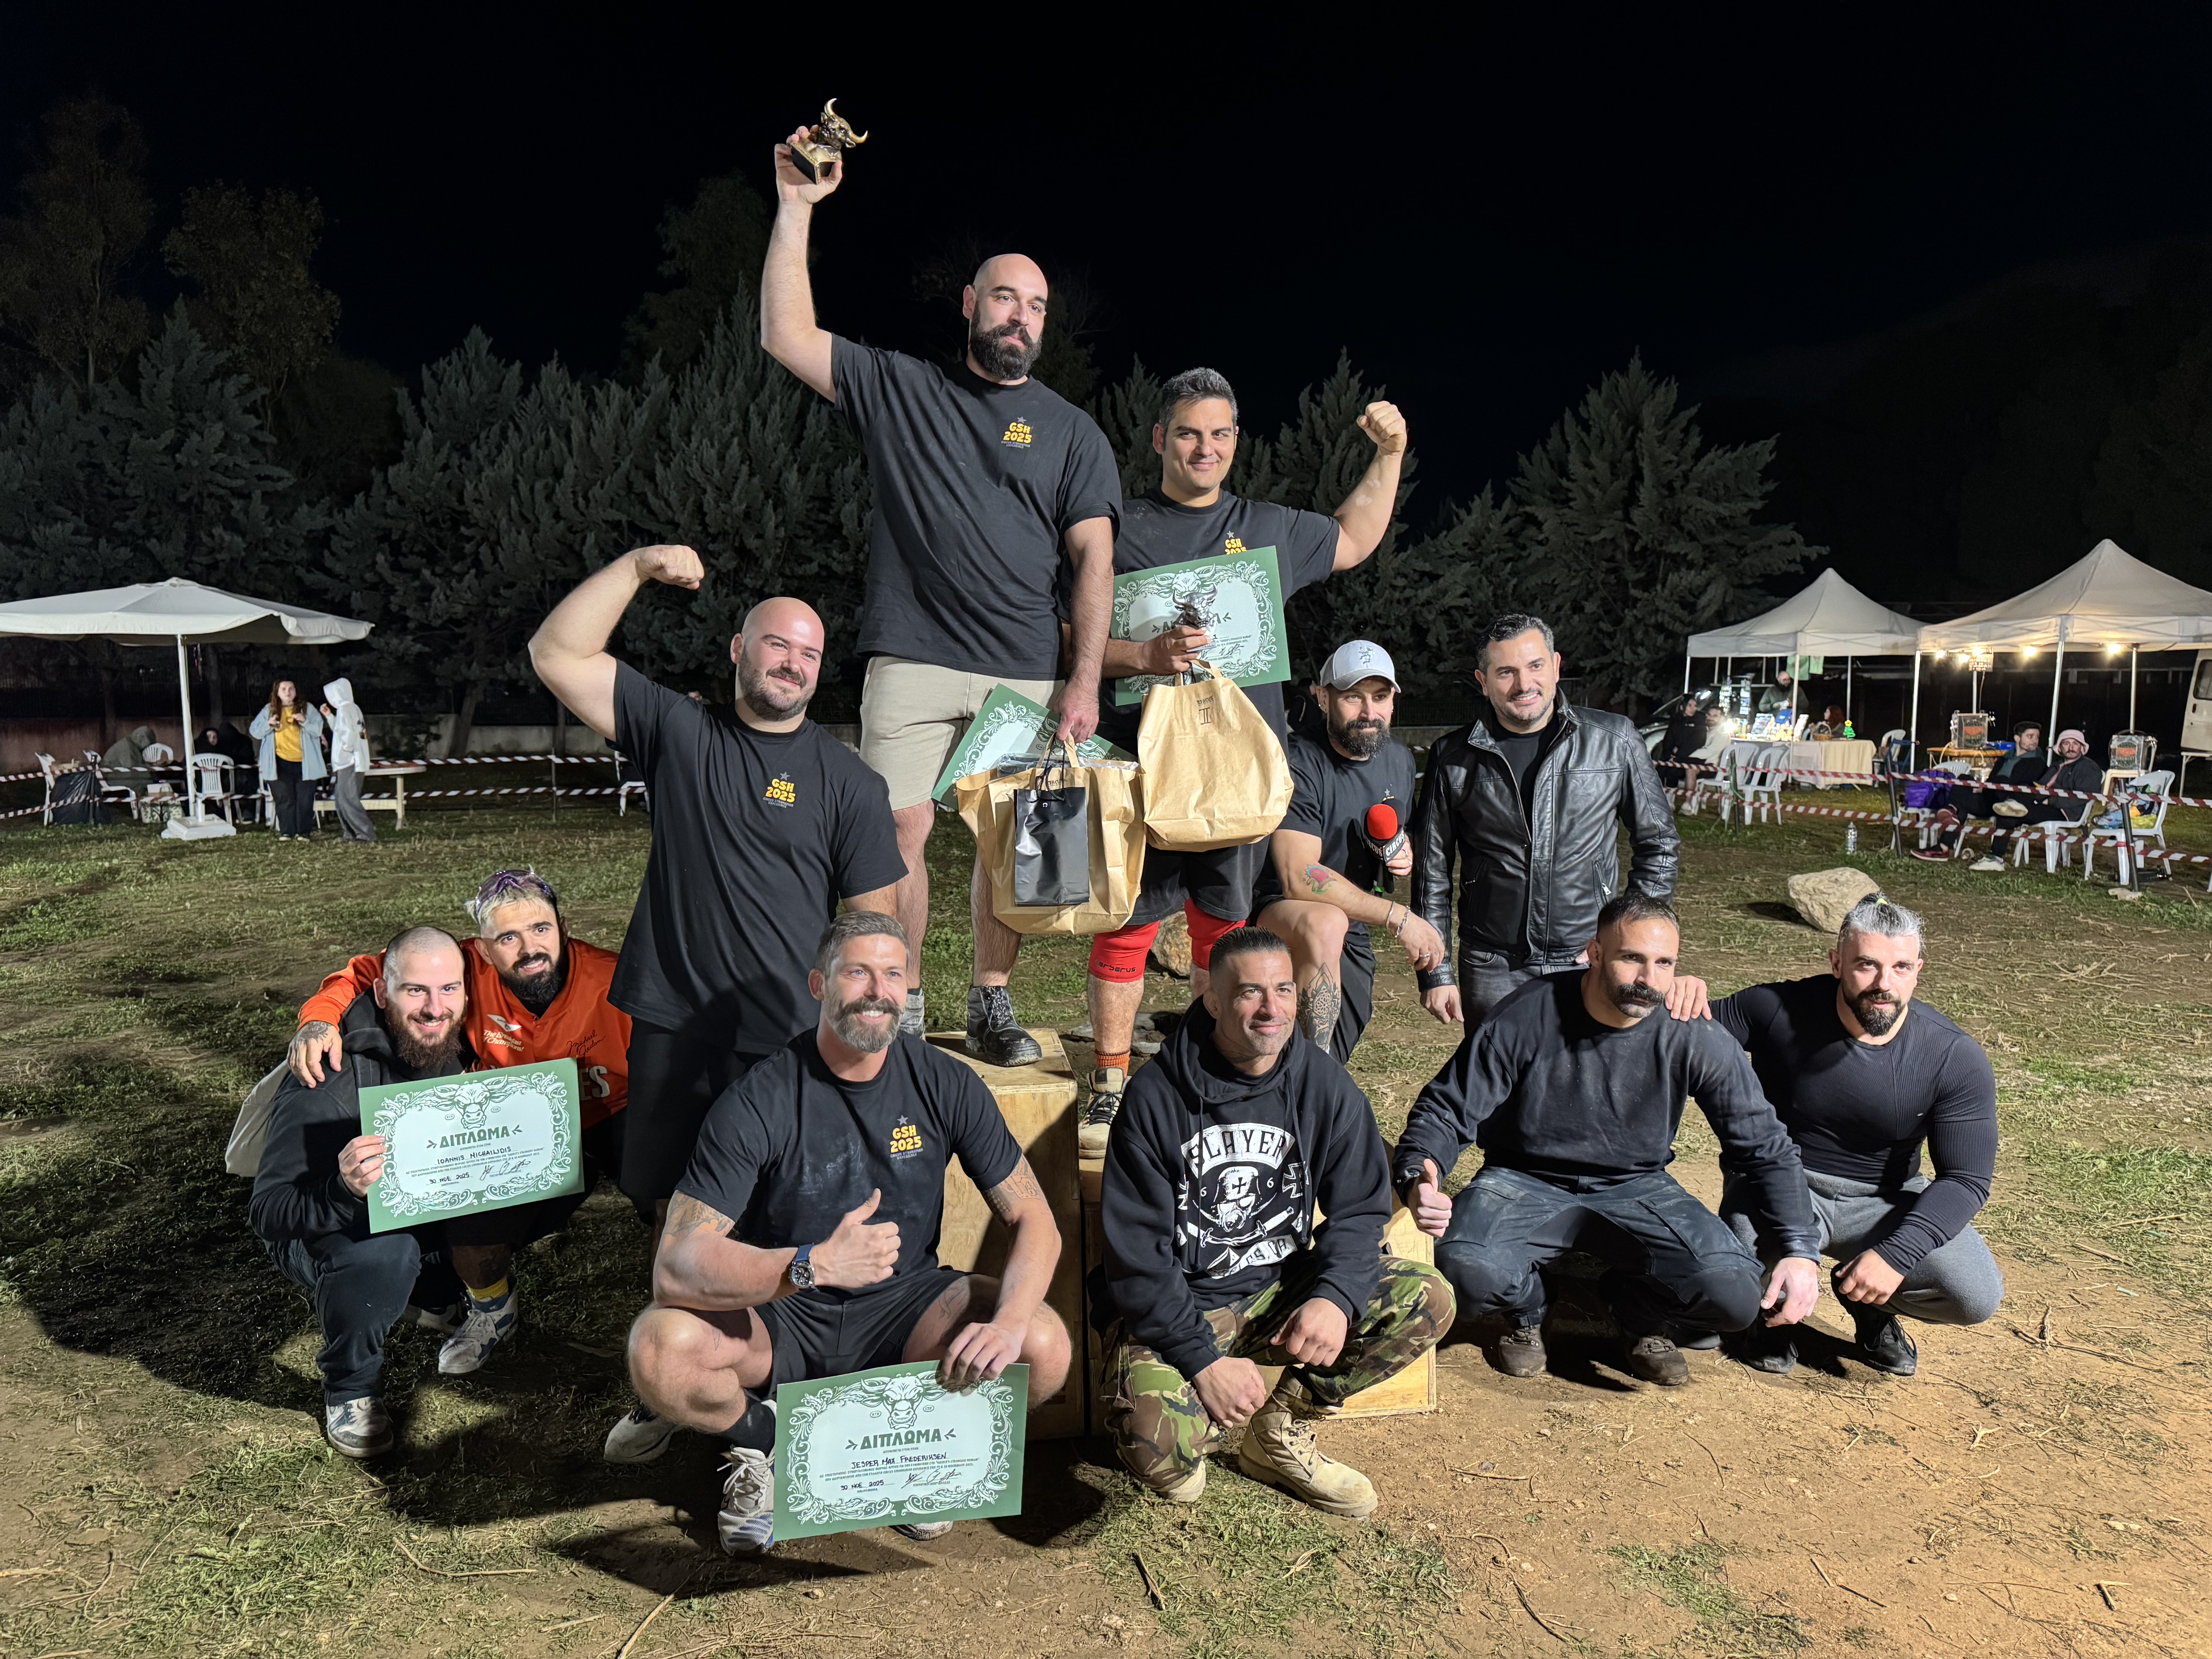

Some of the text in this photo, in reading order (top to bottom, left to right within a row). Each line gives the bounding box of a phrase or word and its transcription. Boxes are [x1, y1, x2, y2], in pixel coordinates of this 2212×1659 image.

[1009, 422, 1031, 434] GSH
[1003, 431, 1032, 443] 2025
[1225, 538, 1242, 549] GSH
[1198, 696, 1213, 705] CIRCUS
[772, 778, 794, 792] GSH
[765, 786, 796, 803] 2025
[1386, 830, 1404, 856] CIRCUS
[483, 1029, 522, 1046] The Breakfast
[487, 1037, 524, 1052] Champions!
[440, 1126, 510, 1148] ΔΙΠΛΩΜΑ
[892, 1125, 917, 1139] GSH
[890, 1135, 922, 1153] 2025
[437, 1155, 464, 1164] IOANNIS
[1266, 1177, 1274, 1188] 6
[860, 1428, 942, 1450] ΔΙΠΛΩΜΑ
[851, 1451, 947, 1469] JESPER MAX FREDERIKSEN
